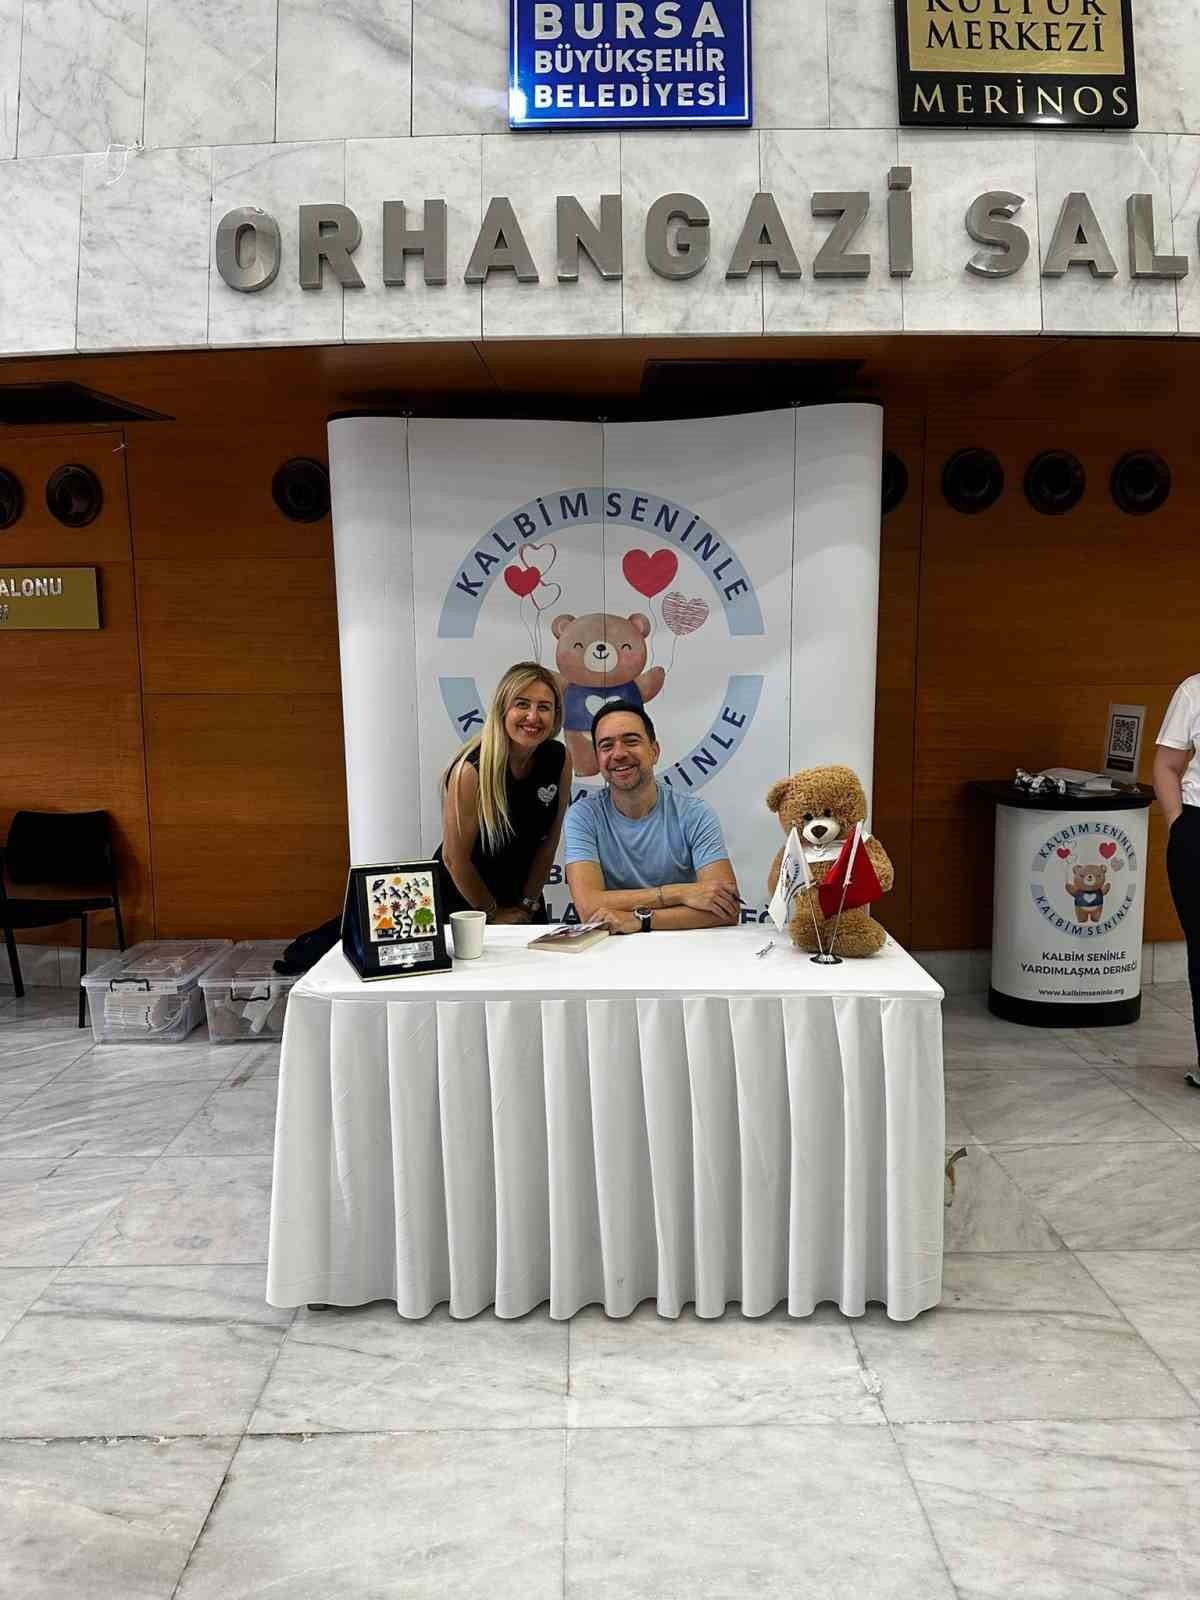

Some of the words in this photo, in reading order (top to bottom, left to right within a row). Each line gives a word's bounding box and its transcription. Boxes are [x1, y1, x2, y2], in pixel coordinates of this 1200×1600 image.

[534, 1, 726, 40] BURSA
[926, 16, 1105, 52] MERKEZİ
[534, 41, 726, 77] BÜYÜKŞEHİR
[534, 74, 727, 108] BELEDİYESİ
[912, 79, 1129, 116] MERİNOS
[215, 166, 913, 292] ORHANGAZİ
[964, 190, 1200, 279] SAL
[455, 492, 589, 597] KALBİM
[605, 492, 749, 601] SENİNLE
[663, 706, 747, 786] İNLE
[1021, 962, 1101, 978] YARDIMLAŞMA
[1042, 951, 1084, 961] KALBİM
[1087, 950, 1126, 962] SENİNLE
